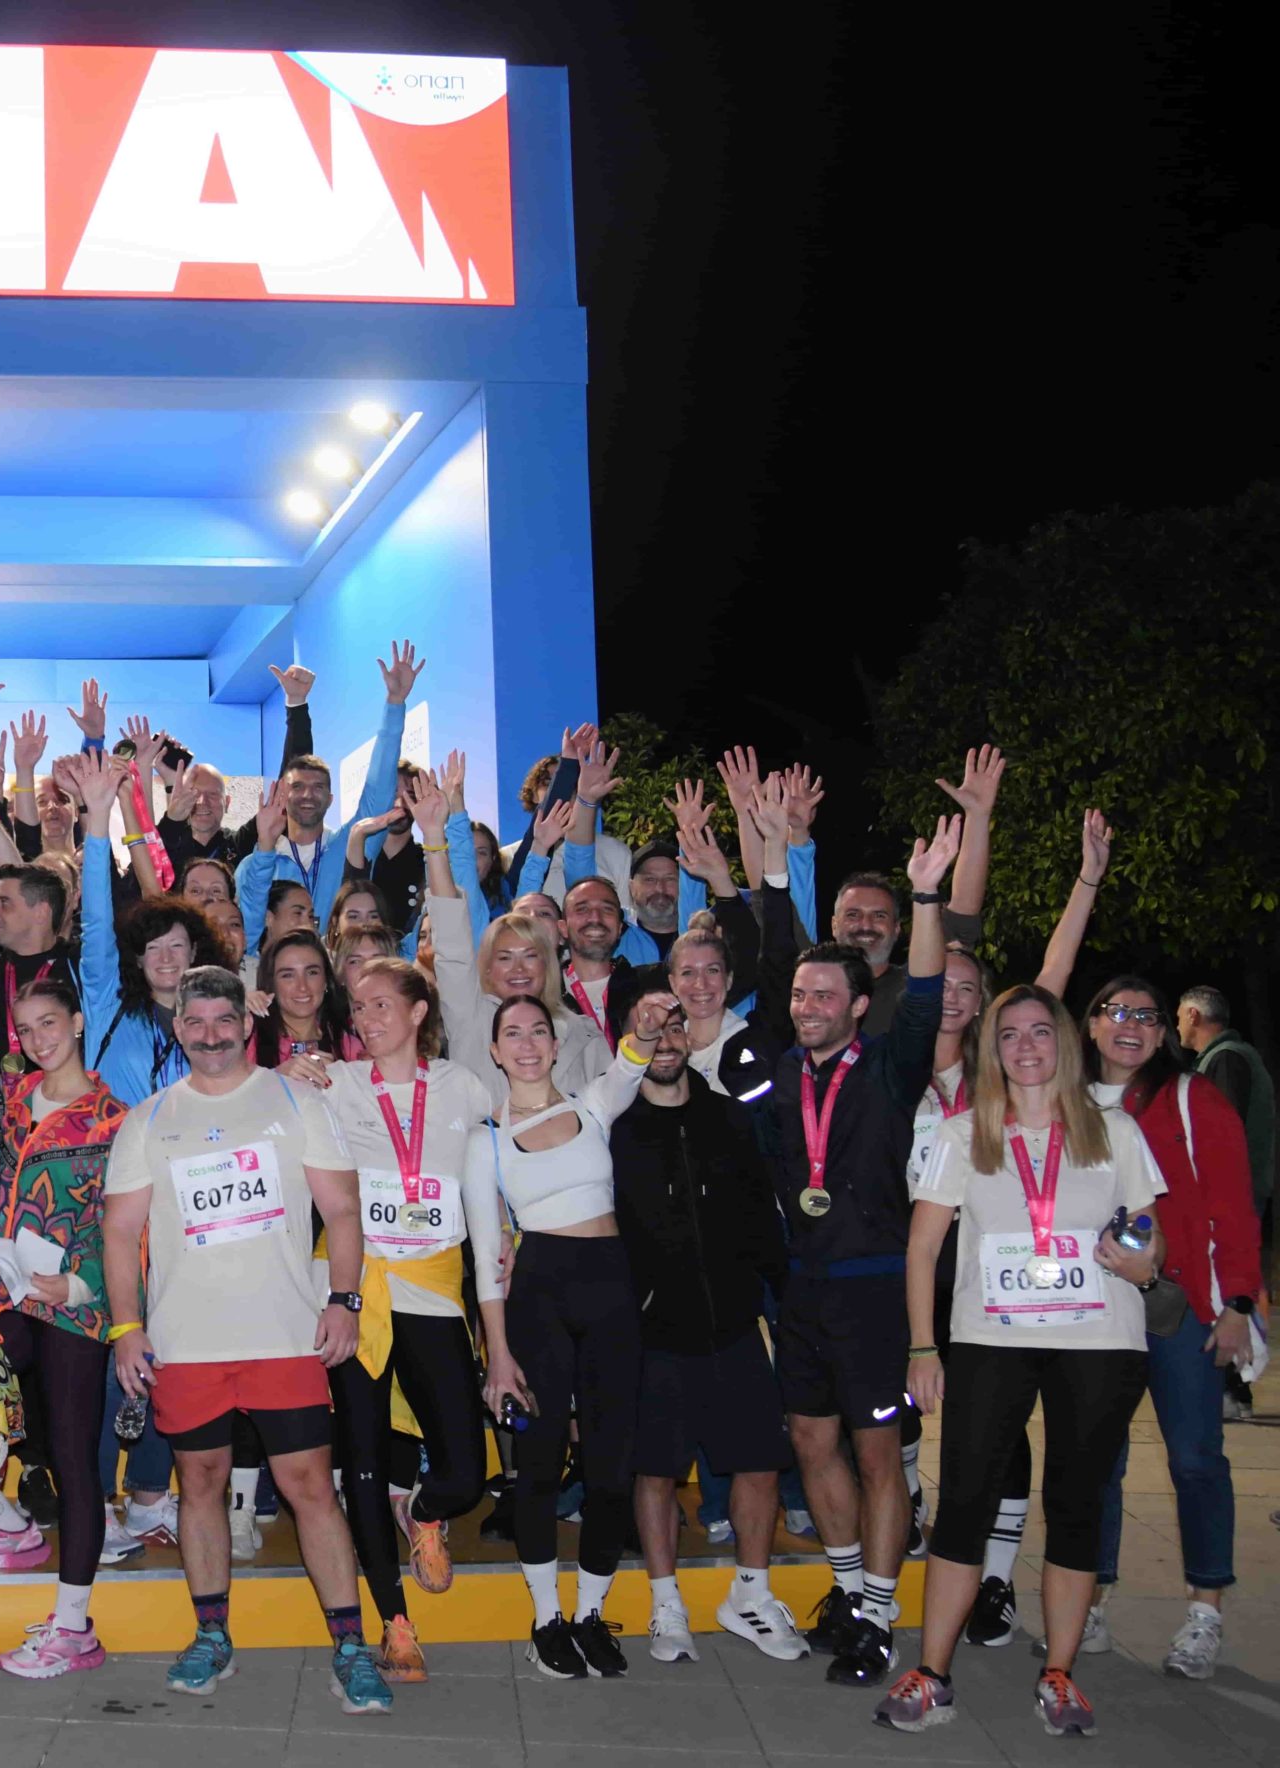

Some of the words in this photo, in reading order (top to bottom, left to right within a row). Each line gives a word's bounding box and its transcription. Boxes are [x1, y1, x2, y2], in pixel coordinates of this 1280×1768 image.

[193, 1177, 268, 1211] 60784
[369, 1203, 442, 1227] 608
[999, 1266, 1085, 1291] 6090
